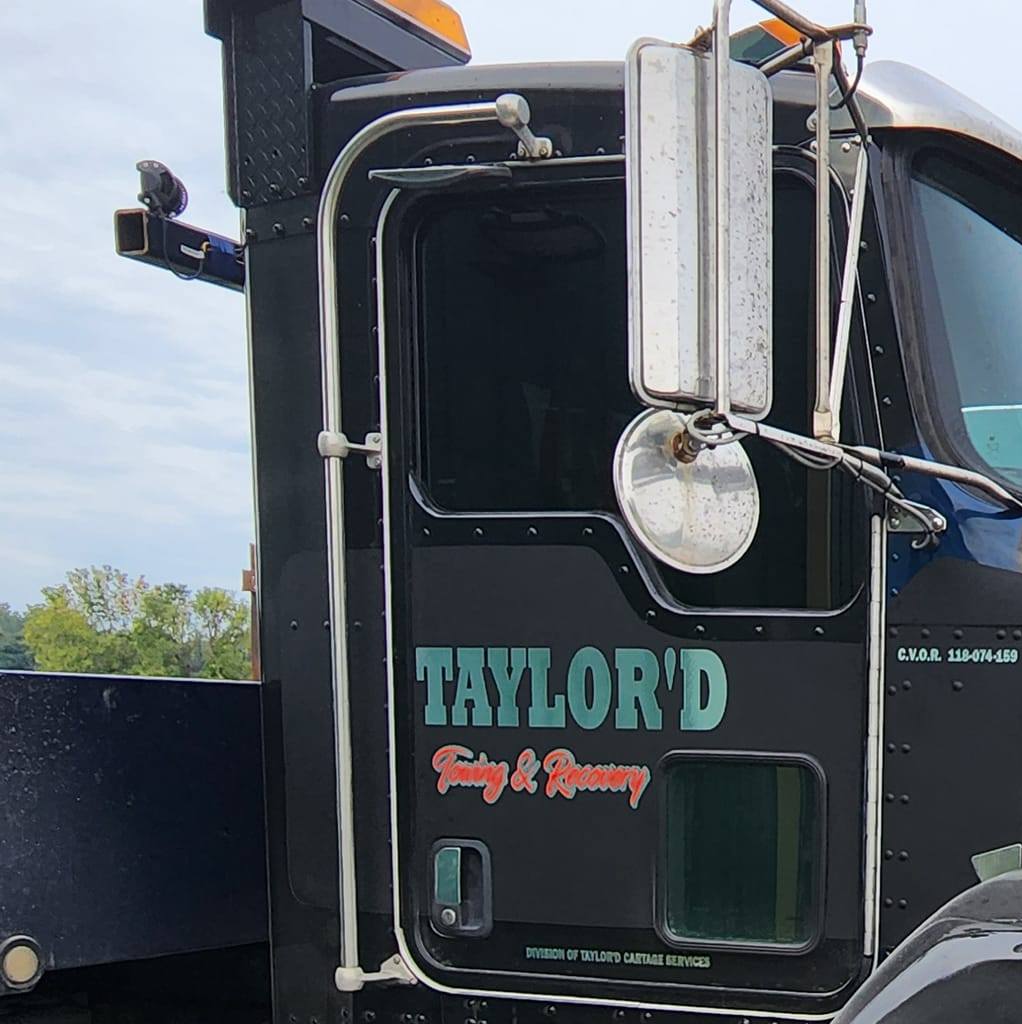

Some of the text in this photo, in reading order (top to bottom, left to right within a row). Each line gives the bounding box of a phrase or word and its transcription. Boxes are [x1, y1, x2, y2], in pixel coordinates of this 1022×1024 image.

[897, 647, 1018, 663] C.V.O.R. 118-074-159
[415, 646, 728, 731] TAYLOR'D
[432, 745, 651, 809] Towing & Recovery
[526, 946, 565, 961] DIVISION
[566, 949, 579, 961] OF
[623, 952, 664, 967] CARTAGE
[665, 954, 711, 969] SERVICES
